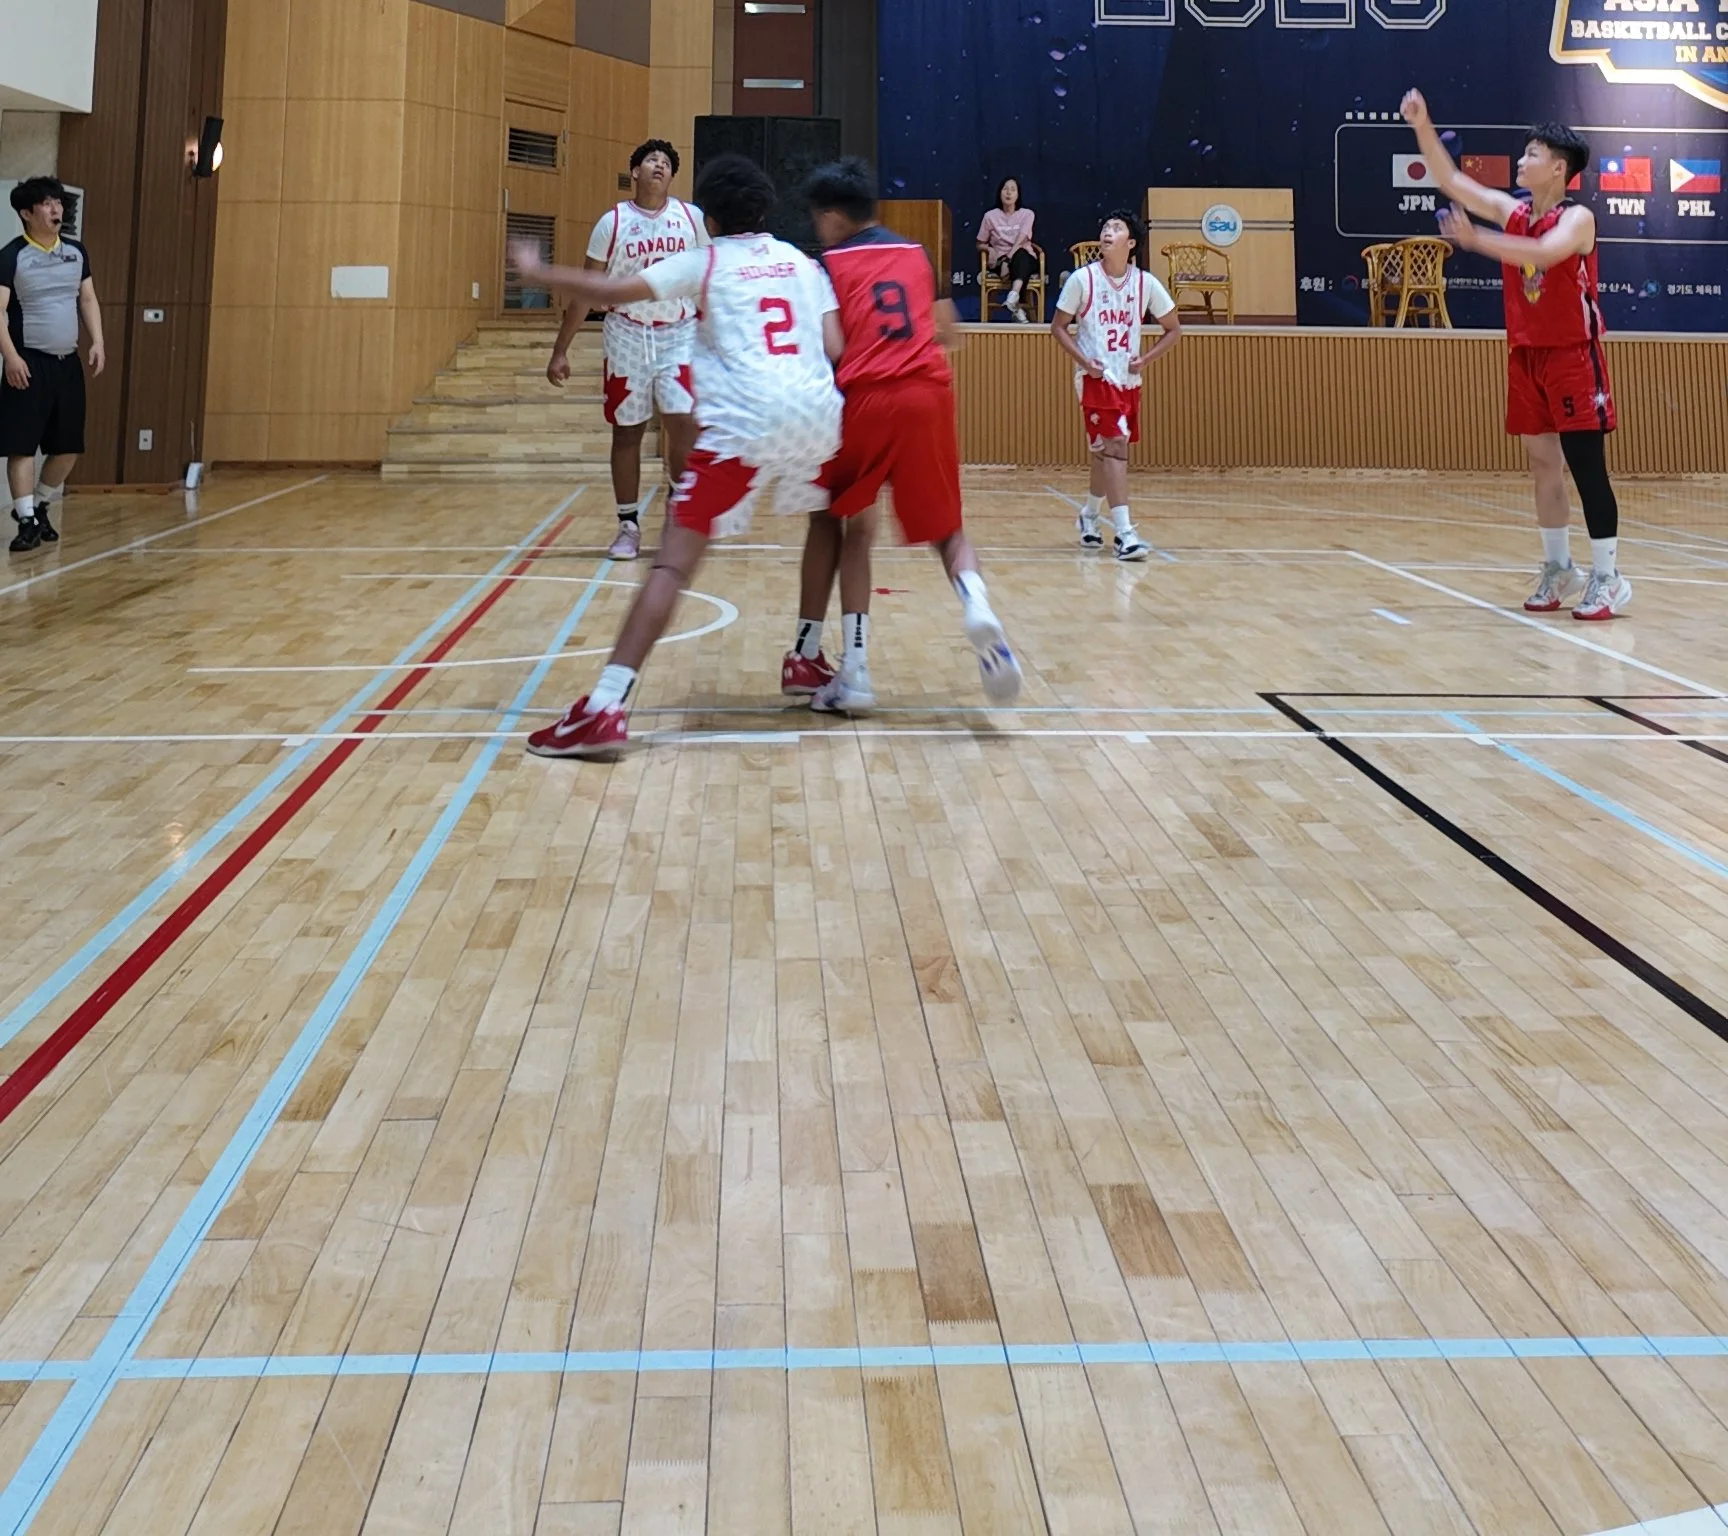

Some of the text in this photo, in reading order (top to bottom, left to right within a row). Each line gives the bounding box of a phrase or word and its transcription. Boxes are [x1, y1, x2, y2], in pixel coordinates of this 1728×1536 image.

[1570, 19, 1712, 41] BASKETBALL
[1675, 45, 1698, 63] IN
[1398, 194, 1436, 211] JPN
[1606, 197, 1646, 216] TWN
[1677, 199, 1716, 217] PHL
[625, 236, 686, 259] CANADA
[1299, 276, 1326, 292] 후원
[872, 281, 914, 340] 9
[760, 297, 799, 355] 2
[1107, 328, 1130, 353] 24
